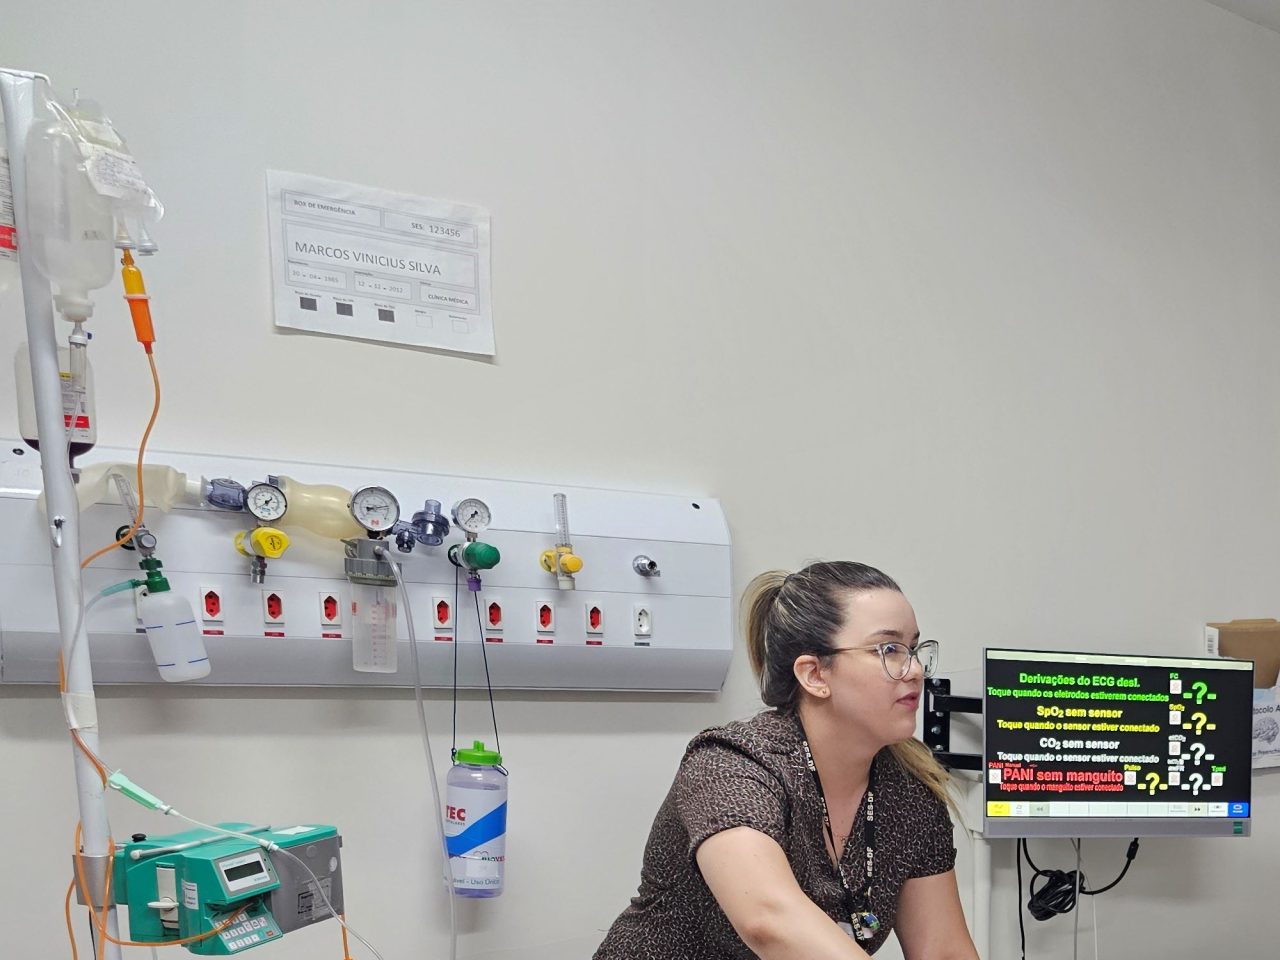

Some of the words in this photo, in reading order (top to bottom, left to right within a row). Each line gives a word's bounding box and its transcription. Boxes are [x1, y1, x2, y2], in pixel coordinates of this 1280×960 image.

[293, 199, 306, 207] BOX
[429, 225, 461, 238] 123456
[295, 241, 350, 261] MARCOS
[352, 250, 406, 271] VINICIUS
[408, 260, 442, 276] SILVA
[1019, 672, 1076, 686] Derivações
[1076, 675, 1091, 686] do
[1092, 676, 1115, 687] ECG
[1169, 672, 1179, 680] FC
[987, 686, 1012, 698] Toque
[1012, 688, 1042, 699] quando
[1042, 690, 1053, 698] os
[1054, 689, 1090, 699] eletrodos
[1090, 691, 1127, 701] estiverem
[1127, 693, 1170, 702] conectados
[1065, 708, 1087, 718] sem
[1088, 708, 1124, 719] sensor
[996, 719, 1023, 731] Toque
[1023, 721, 1055, 732] quando
[1055, 722, 1062, 730] o
[1062, 722, 1091, 731] sensor
[1091, 722, 1119, 732] estiver
[1119, 723, 1160, 733] conectado
[1062, 740, 1084, 749] sem
[1085, 740, 1120, 750] sensor
[996, 751, 1023, 762] Toque
[1023, 752, 1055, 763] quando
[1062, 754, 1091, 762] sensor
[1091, 753, 1119, 762] estiver
[1119, 754, 1160, 764] conectado
[1003, 768, 1034, 781] PANI
[1036, 771, 1063, 781] sem
[1066, 769, 1123, 784] manguito
[1000, 781, 1018, 792] Toque
[1018, 781, 1041, 792] quando
[1046, 782, 1074, 793] manguito
[1074, 783, 1094, 791] estiver
[1094, 783, 1124, 792] conectado
[866, 791, 874, 822] SES-DF
[866, 846, 874, 878] SES-DF
